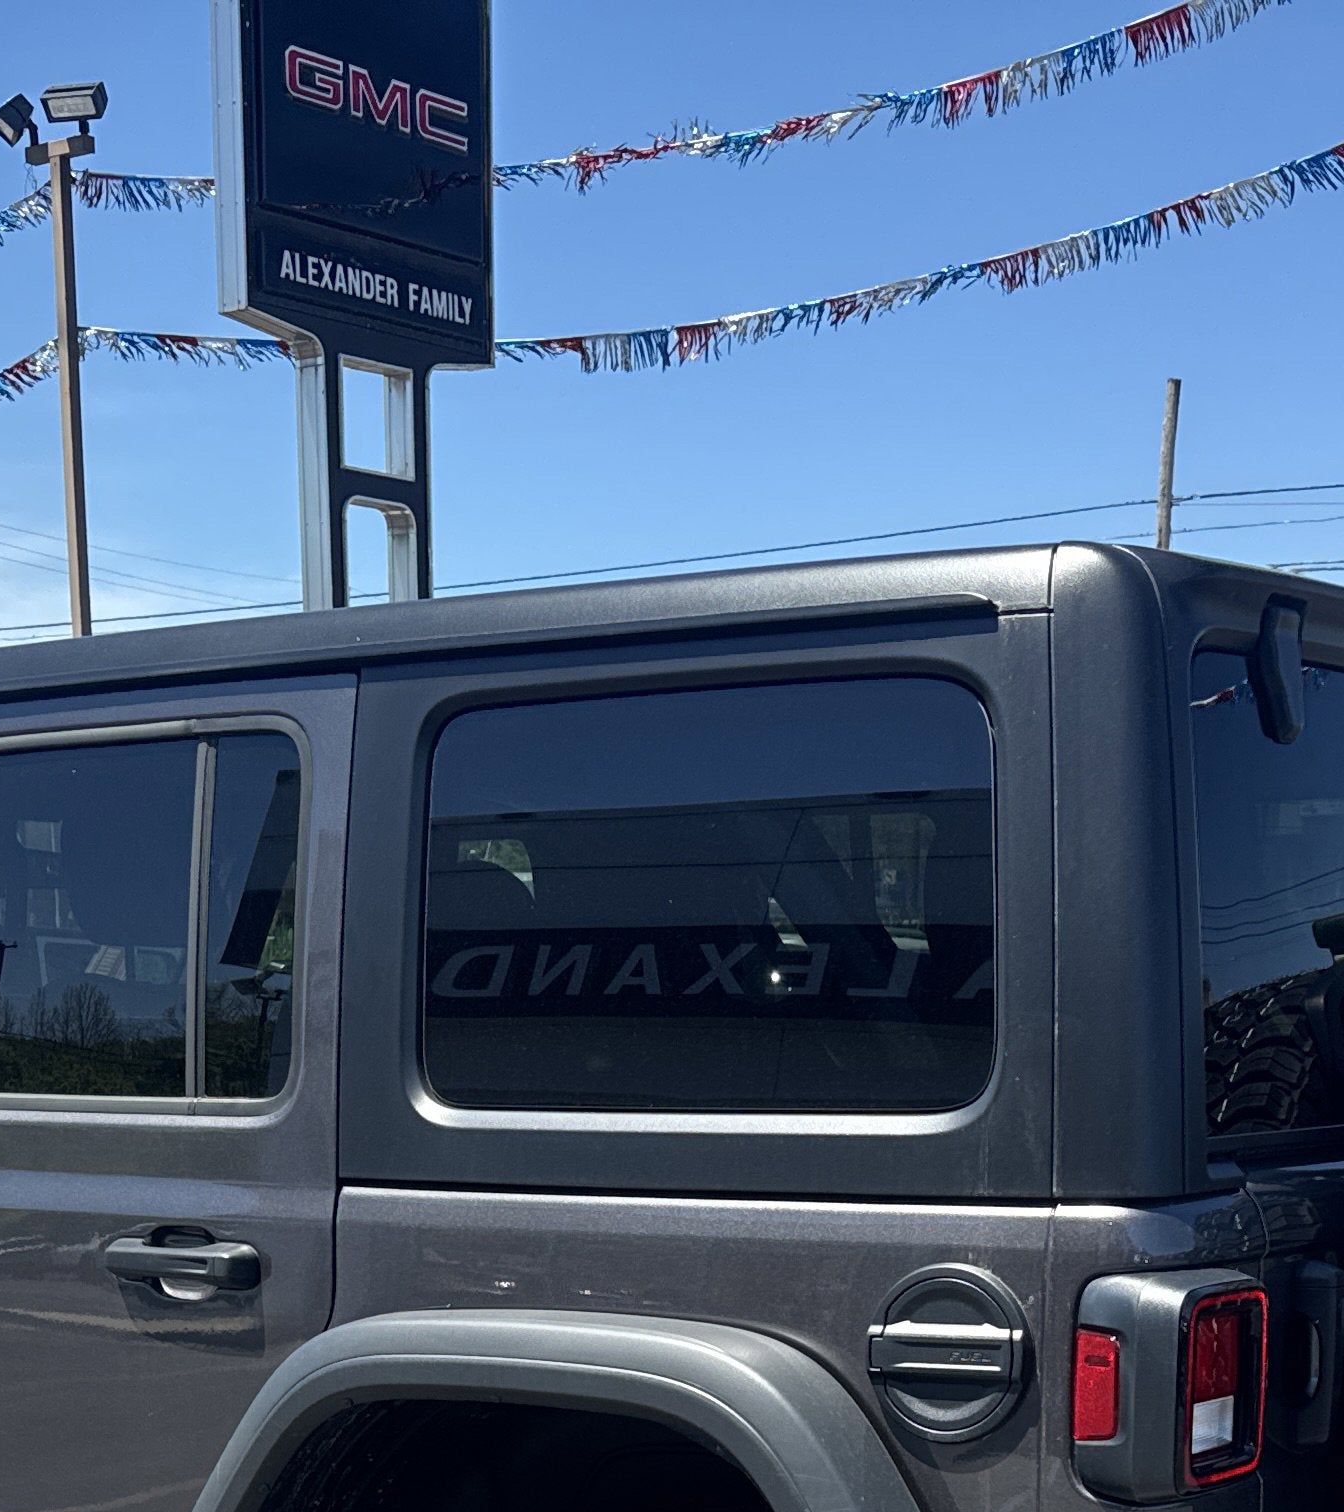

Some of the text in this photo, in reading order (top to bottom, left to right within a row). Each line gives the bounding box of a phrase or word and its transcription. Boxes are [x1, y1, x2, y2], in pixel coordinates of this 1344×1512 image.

[285, 45, 468, 152] GMC
[280, 249, 473, 326] ALEXANDER FAMILY
[949, 1350, 992, 1363] FUEL
